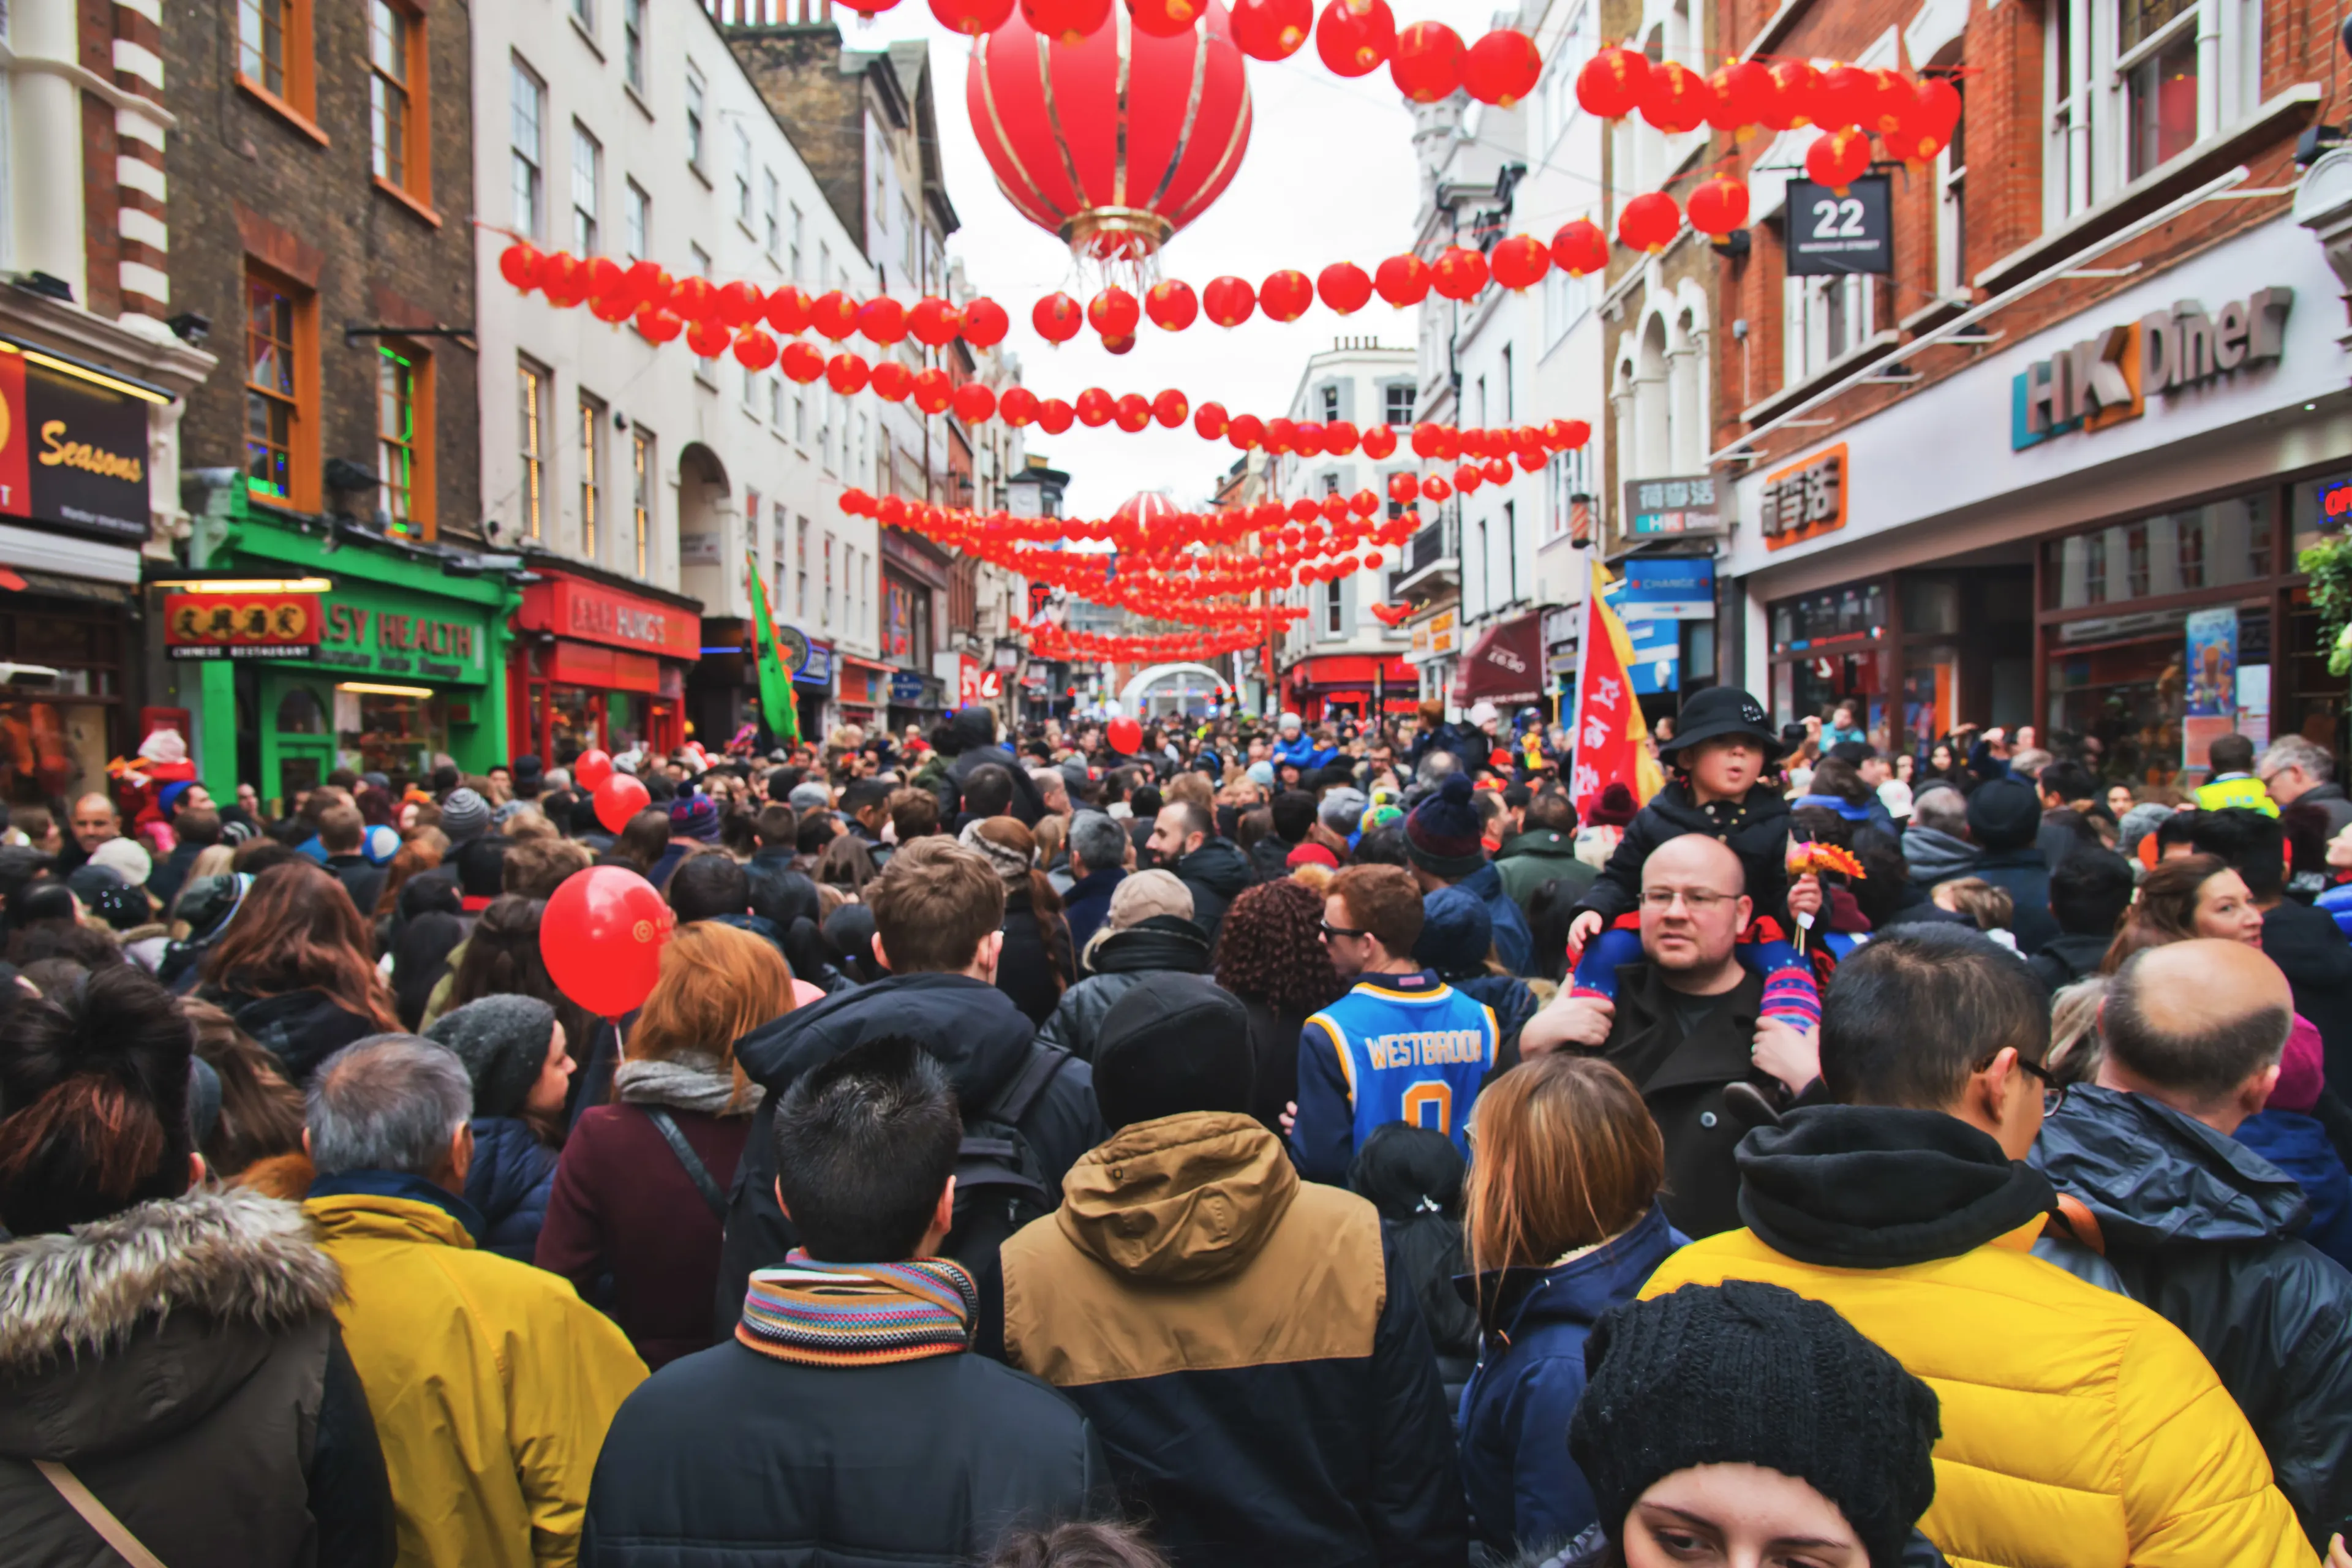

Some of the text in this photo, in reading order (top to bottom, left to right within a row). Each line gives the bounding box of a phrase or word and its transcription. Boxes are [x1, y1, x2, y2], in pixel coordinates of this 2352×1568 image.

[1812, 198, 1865, 238] 22
[2027, 287, 2294, 434] HK Diner
[38, 420, 143, 483] Seasons
[2325, 487, 2352, 516] OP
[172, 646, 310, 658] CHINESE RESTAURANT
[378, 612, 472, 658] HEALTH
